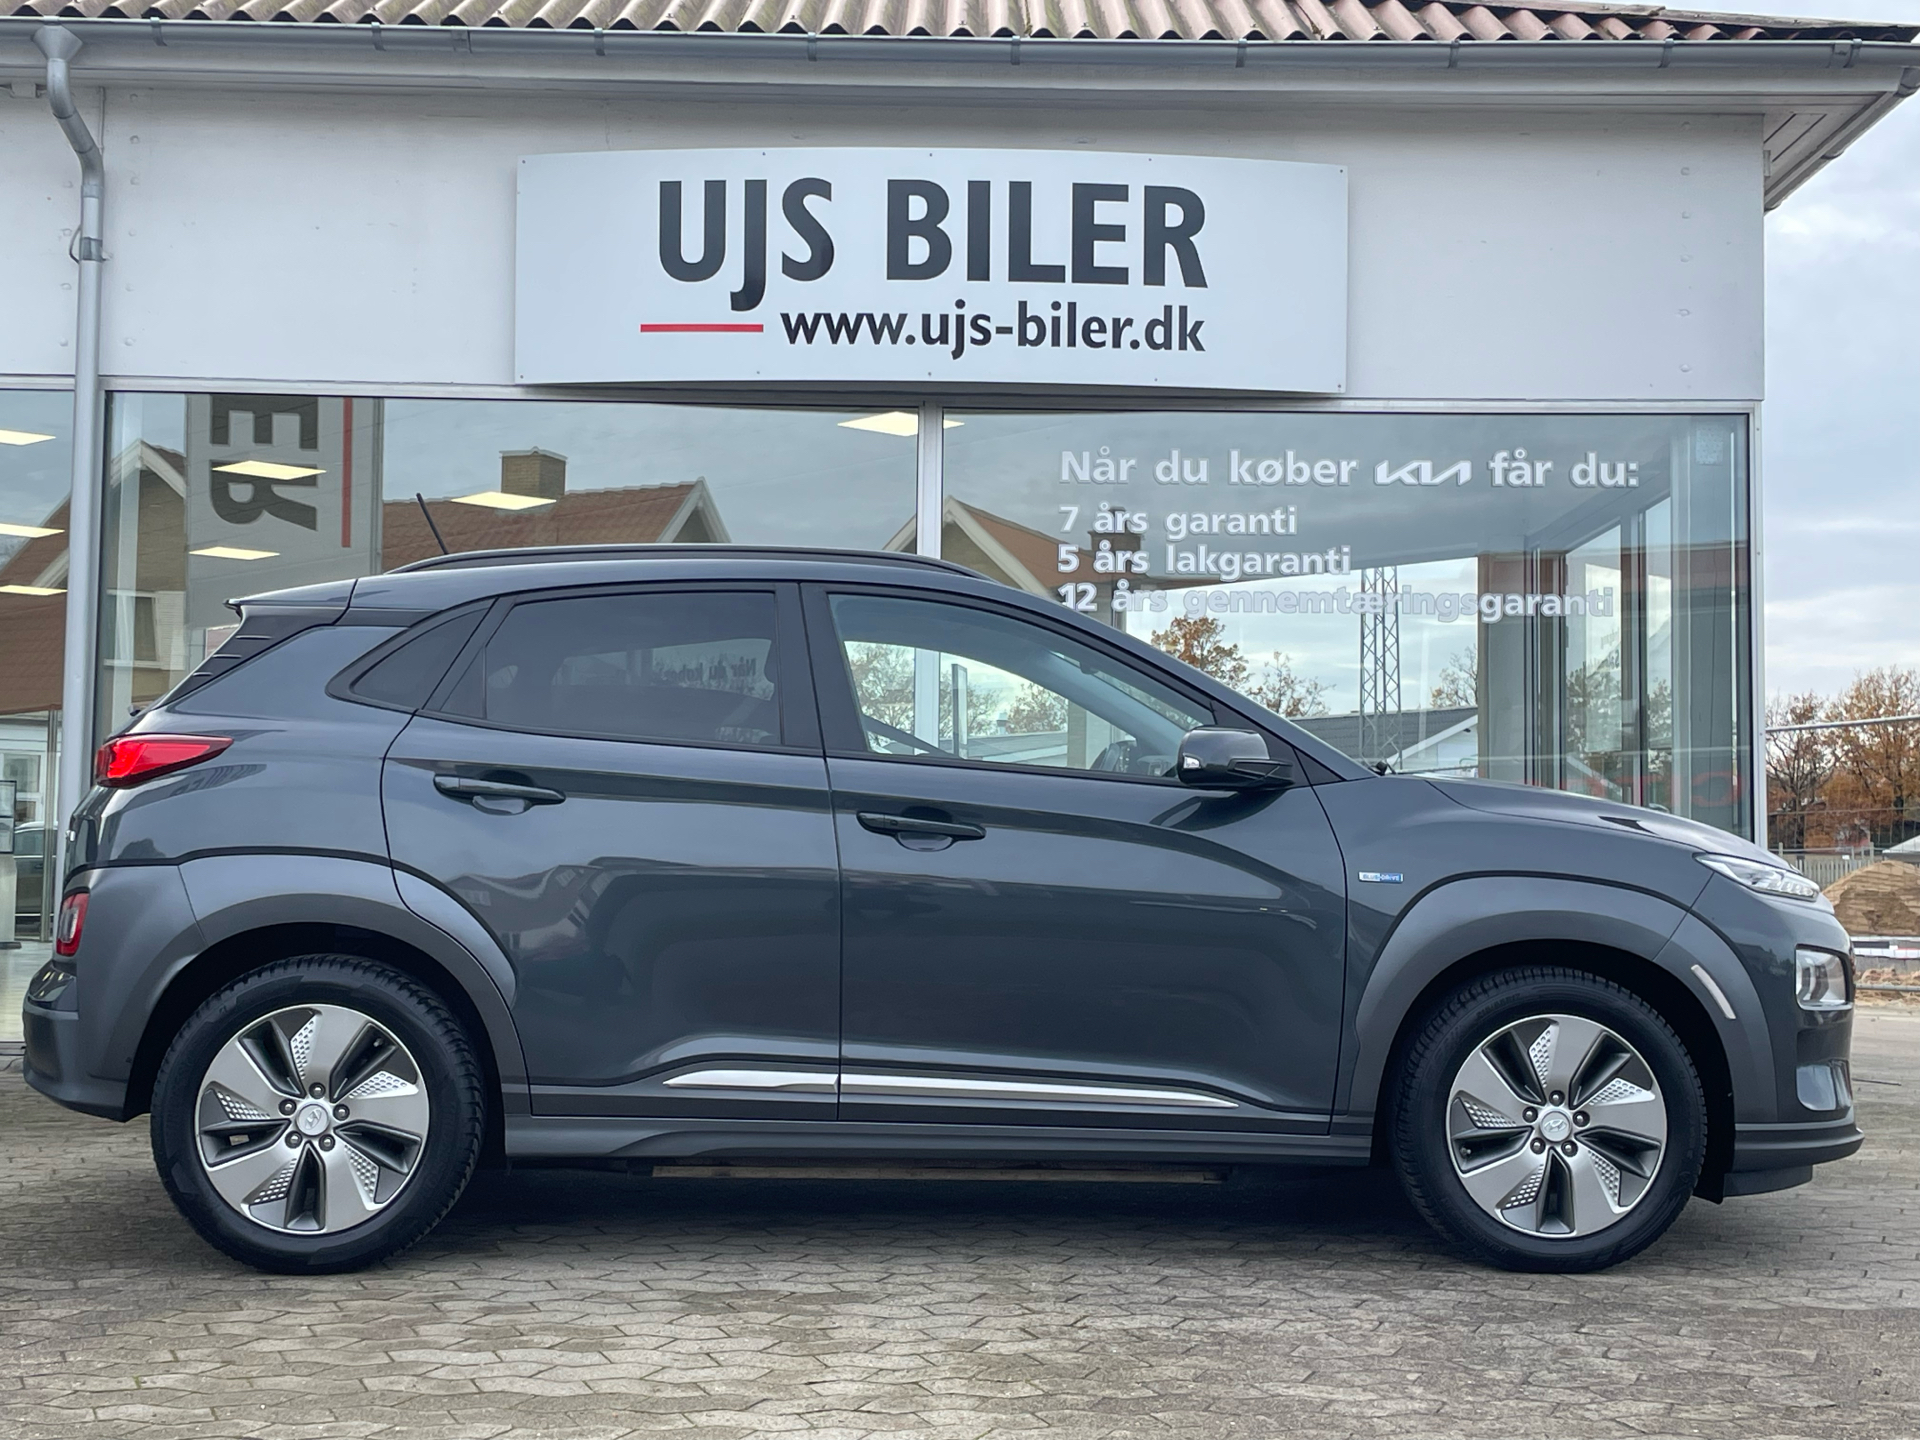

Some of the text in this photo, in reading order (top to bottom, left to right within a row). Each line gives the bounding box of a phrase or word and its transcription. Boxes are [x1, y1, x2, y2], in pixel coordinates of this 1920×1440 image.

[659, 177, 1209, 312] UJS BILER
[779, 298, 1207, 361] www.ujs-biler.dk
[1059, 445, 1137, 484] Når
[1154, 449, 1209, 484] du
[1228, 449, 1358, 486] køber
[1487, 447, 1553, 487] får
[1568, 451, 1639, 488] du:
[1059, 500, 1298, 541] 7 års garanti
[1057, 539, 1352, 582] 5 års lakgaranti
[1056, 577, 1615, 624] 12 års gennemtæringsgaranti
